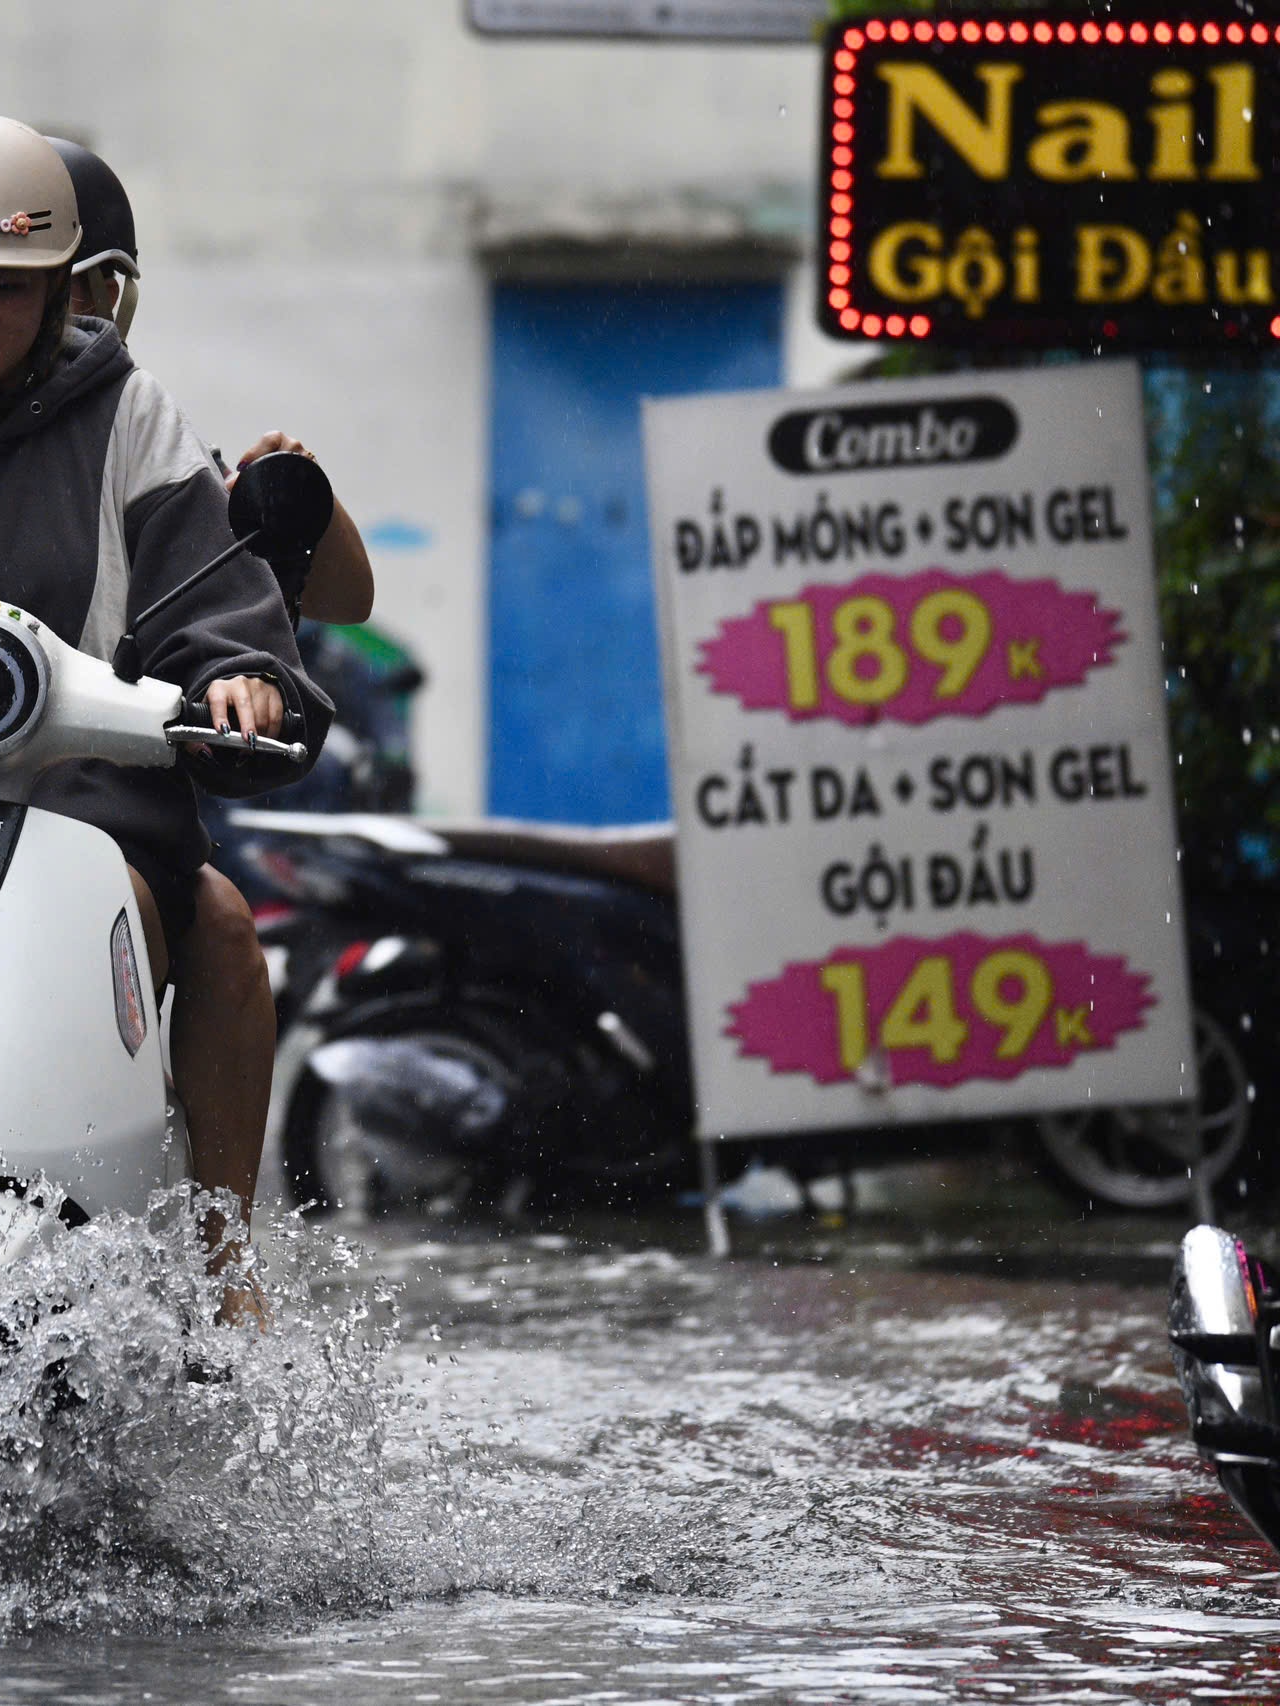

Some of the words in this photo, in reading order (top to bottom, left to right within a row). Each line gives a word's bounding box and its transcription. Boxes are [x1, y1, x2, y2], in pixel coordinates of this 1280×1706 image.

[878, 63, 1258, 180] Nail
[869, 222, 1040, 317] Gội
[1076, 212, 1273, 304] Đầu
[803, 407, 977, 470] Combo
[773, 493, 906, 566] MÓNG
[1045, 485, 1129, 545] GEL
[810, 765, 881, 822] DA
[1049, 745, 1149, 801] GEL
[820, 842, 916, 930] GỘI
